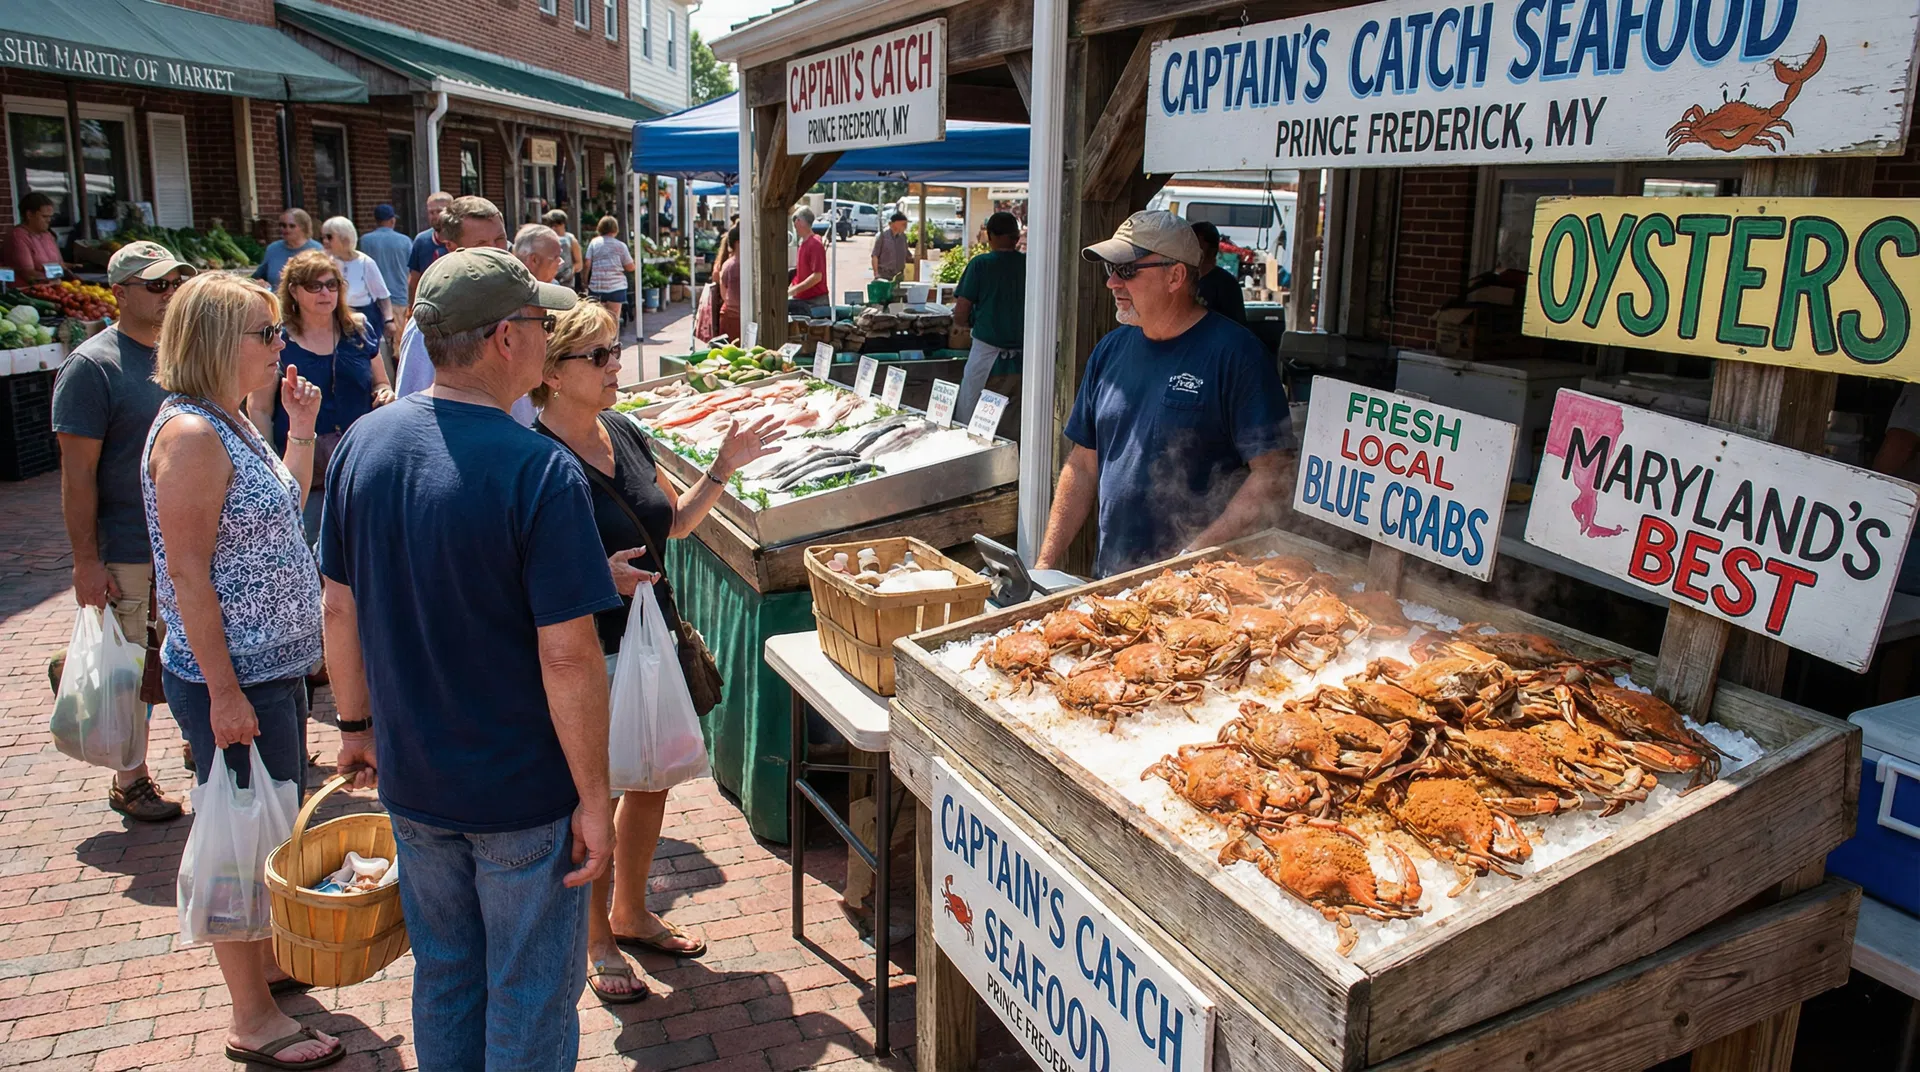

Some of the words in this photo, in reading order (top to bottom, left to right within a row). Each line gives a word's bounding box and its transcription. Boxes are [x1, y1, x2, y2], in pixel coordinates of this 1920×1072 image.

[167, 62, 235, 92] MARKET
[790, 47, 865, 113] CAPTAIN'S
[870, 30, 933, 99] CATCH
[1160, 22, 1331, 117] CAPTAIN'S
[1349, 2, 1495, 98] CATCH
[1507, 0, 1799, 84] SEAFOOD
[808, 116, 836, 145] PRINCE
[838, 107, 890, 141] FREDERICK,
[893, 104, 910, 136] MY
[1275, 114, 1359, 157] PRINCE
[1367, 102, 1533, 155] FREDERICK,
[1545, 96, 1608, 147] MY
[1538, 213, 1920, 364] OYSTERS
[1340, 428, 1455, 491] LOCAL
[1346, 391, 1462, 452] FRESH
[1302, 454, 1376, 526] BLUE
[1380, 481, 1489, 567] CRABS
[1561, 426, 1892, 581] MARYLAND'S
[1627, 513, 1819, 637] BEST
[941, 793, 1067, 949] CAPTAIN'S
[1075, 915, 1184, 1072] CATCH
[984, 907, 1111, 1072] SEAFOOD
[987, 971, 1023, 1032] PRINCE
